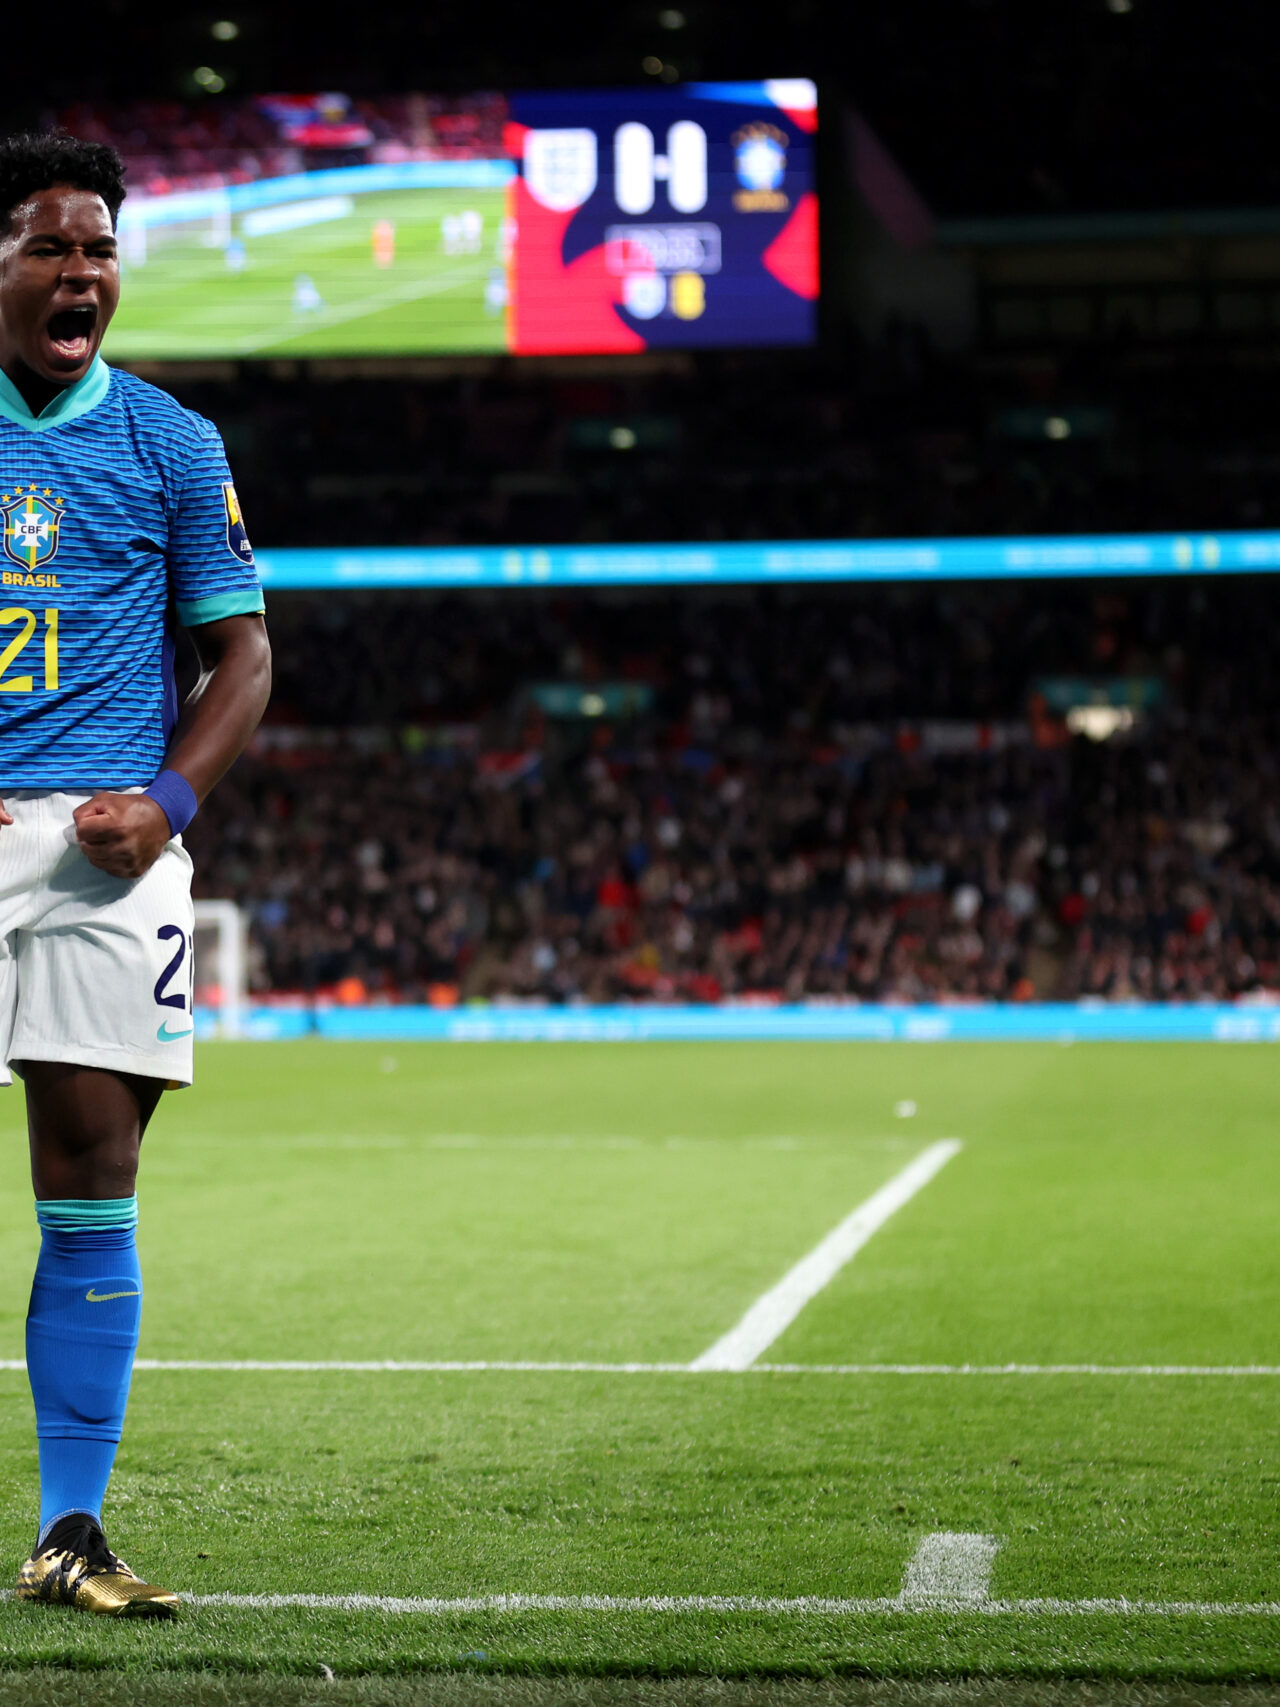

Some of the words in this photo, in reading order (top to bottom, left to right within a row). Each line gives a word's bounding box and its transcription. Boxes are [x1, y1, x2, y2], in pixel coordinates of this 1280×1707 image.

[20, 525, 43, 535] CBF
[2, 571, 62, 588] BRASIL
[153, 924, 192, 1015] 2
